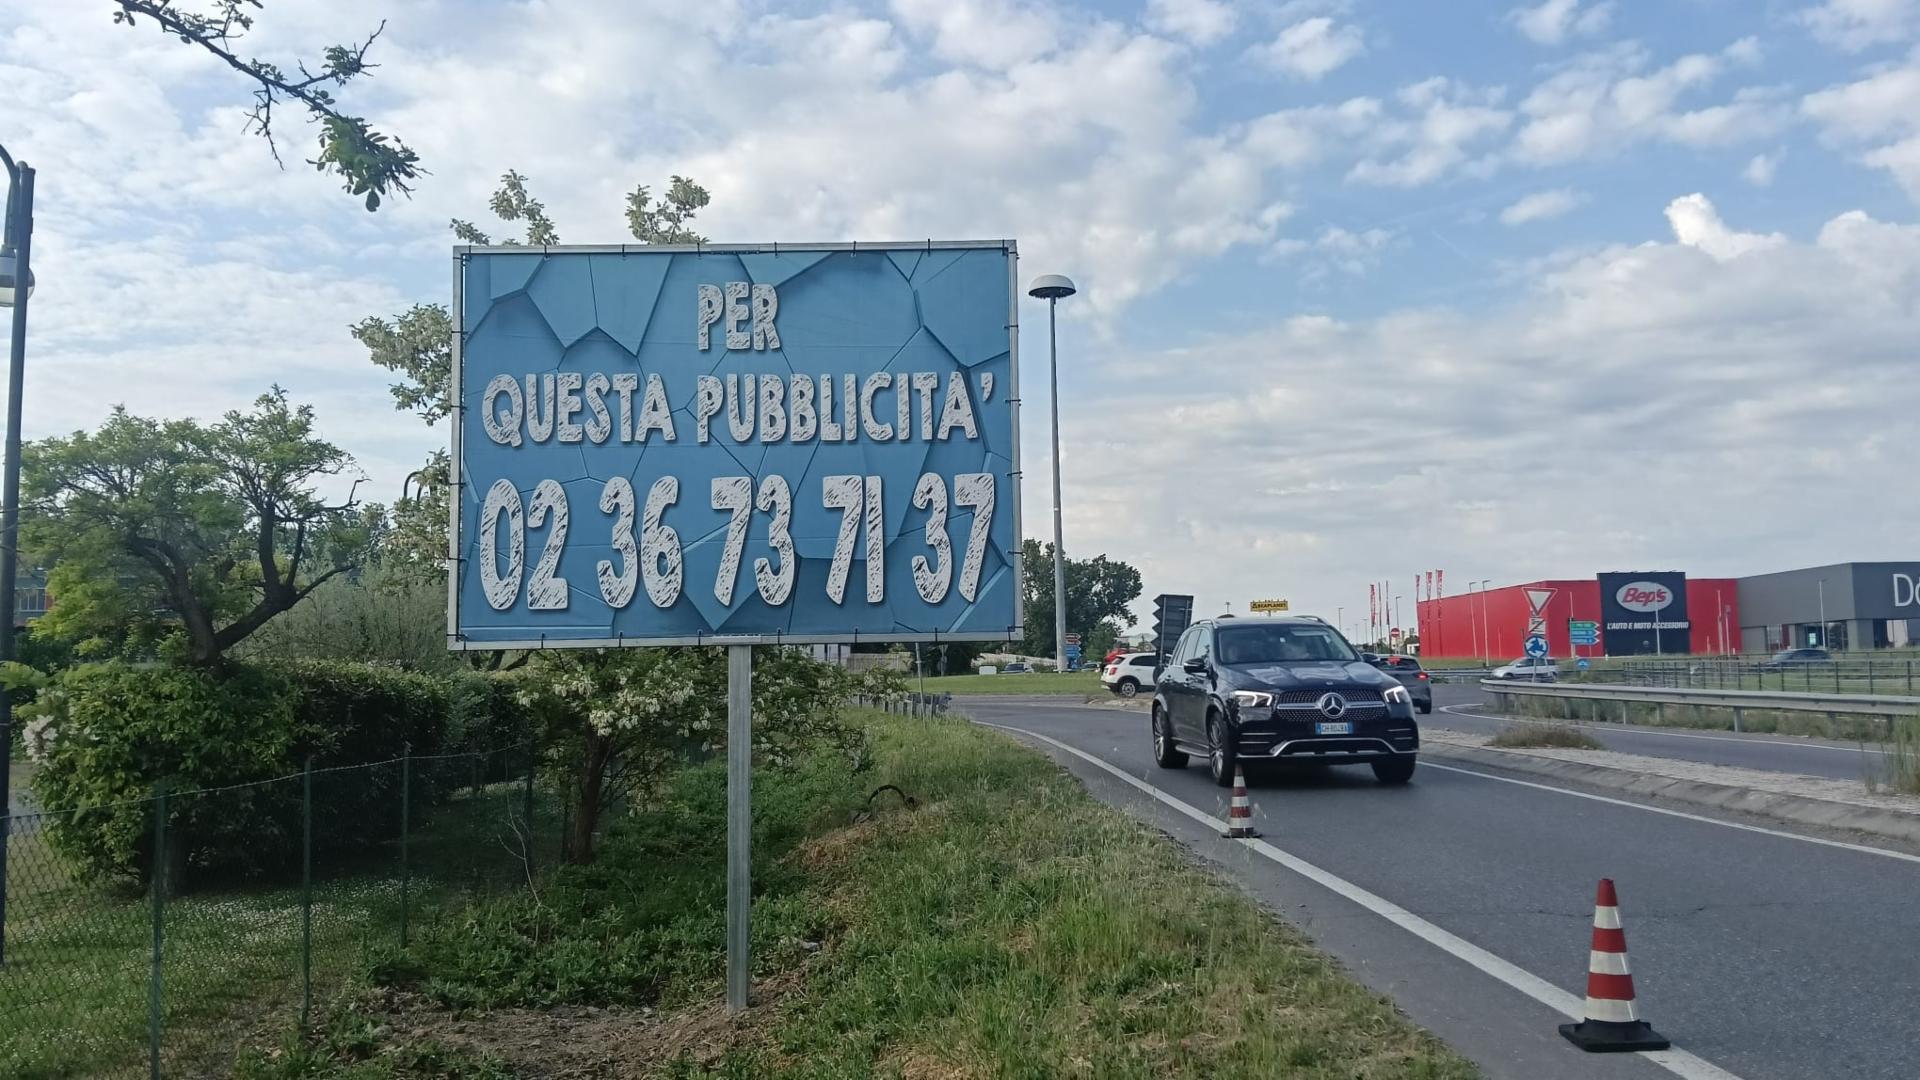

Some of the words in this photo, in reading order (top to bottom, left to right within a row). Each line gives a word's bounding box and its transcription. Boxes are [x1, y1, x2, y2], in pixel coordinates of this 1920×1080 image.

[698, 282, 780, 351] PER
[482, 373, 676, 447] QUESTA
[697, 371, 994, 443] PUBBLICITA'
[480, 478, 569, 610] 02
[597, 475, 683, 609] 36
[711, 474, 795, 606] 73
[823, 474, 884, 605] 71
[911, 472, 995, 604] 37
[1622, 588, 1667, 606] Bep's
